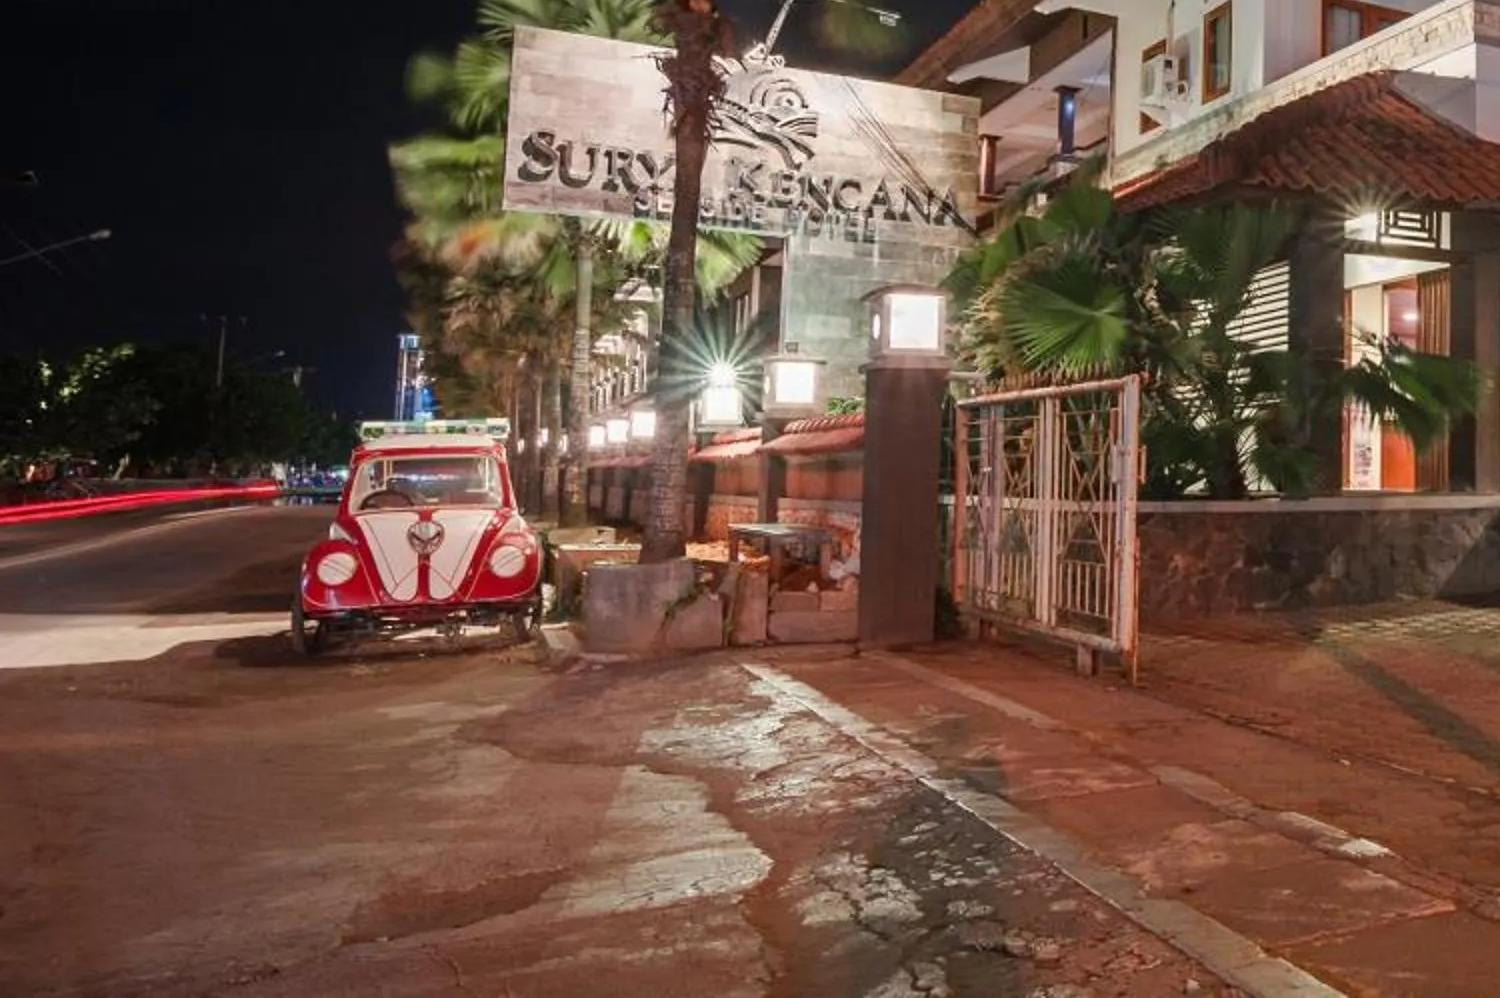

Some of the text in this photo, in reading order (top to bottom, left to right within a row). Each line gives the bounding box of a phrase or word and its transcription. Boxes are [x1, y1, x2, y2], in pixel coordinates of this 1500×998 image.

[518, 129, 971, 228] SURY KENCANA
[632, 185, 764, 231] SESIDE
